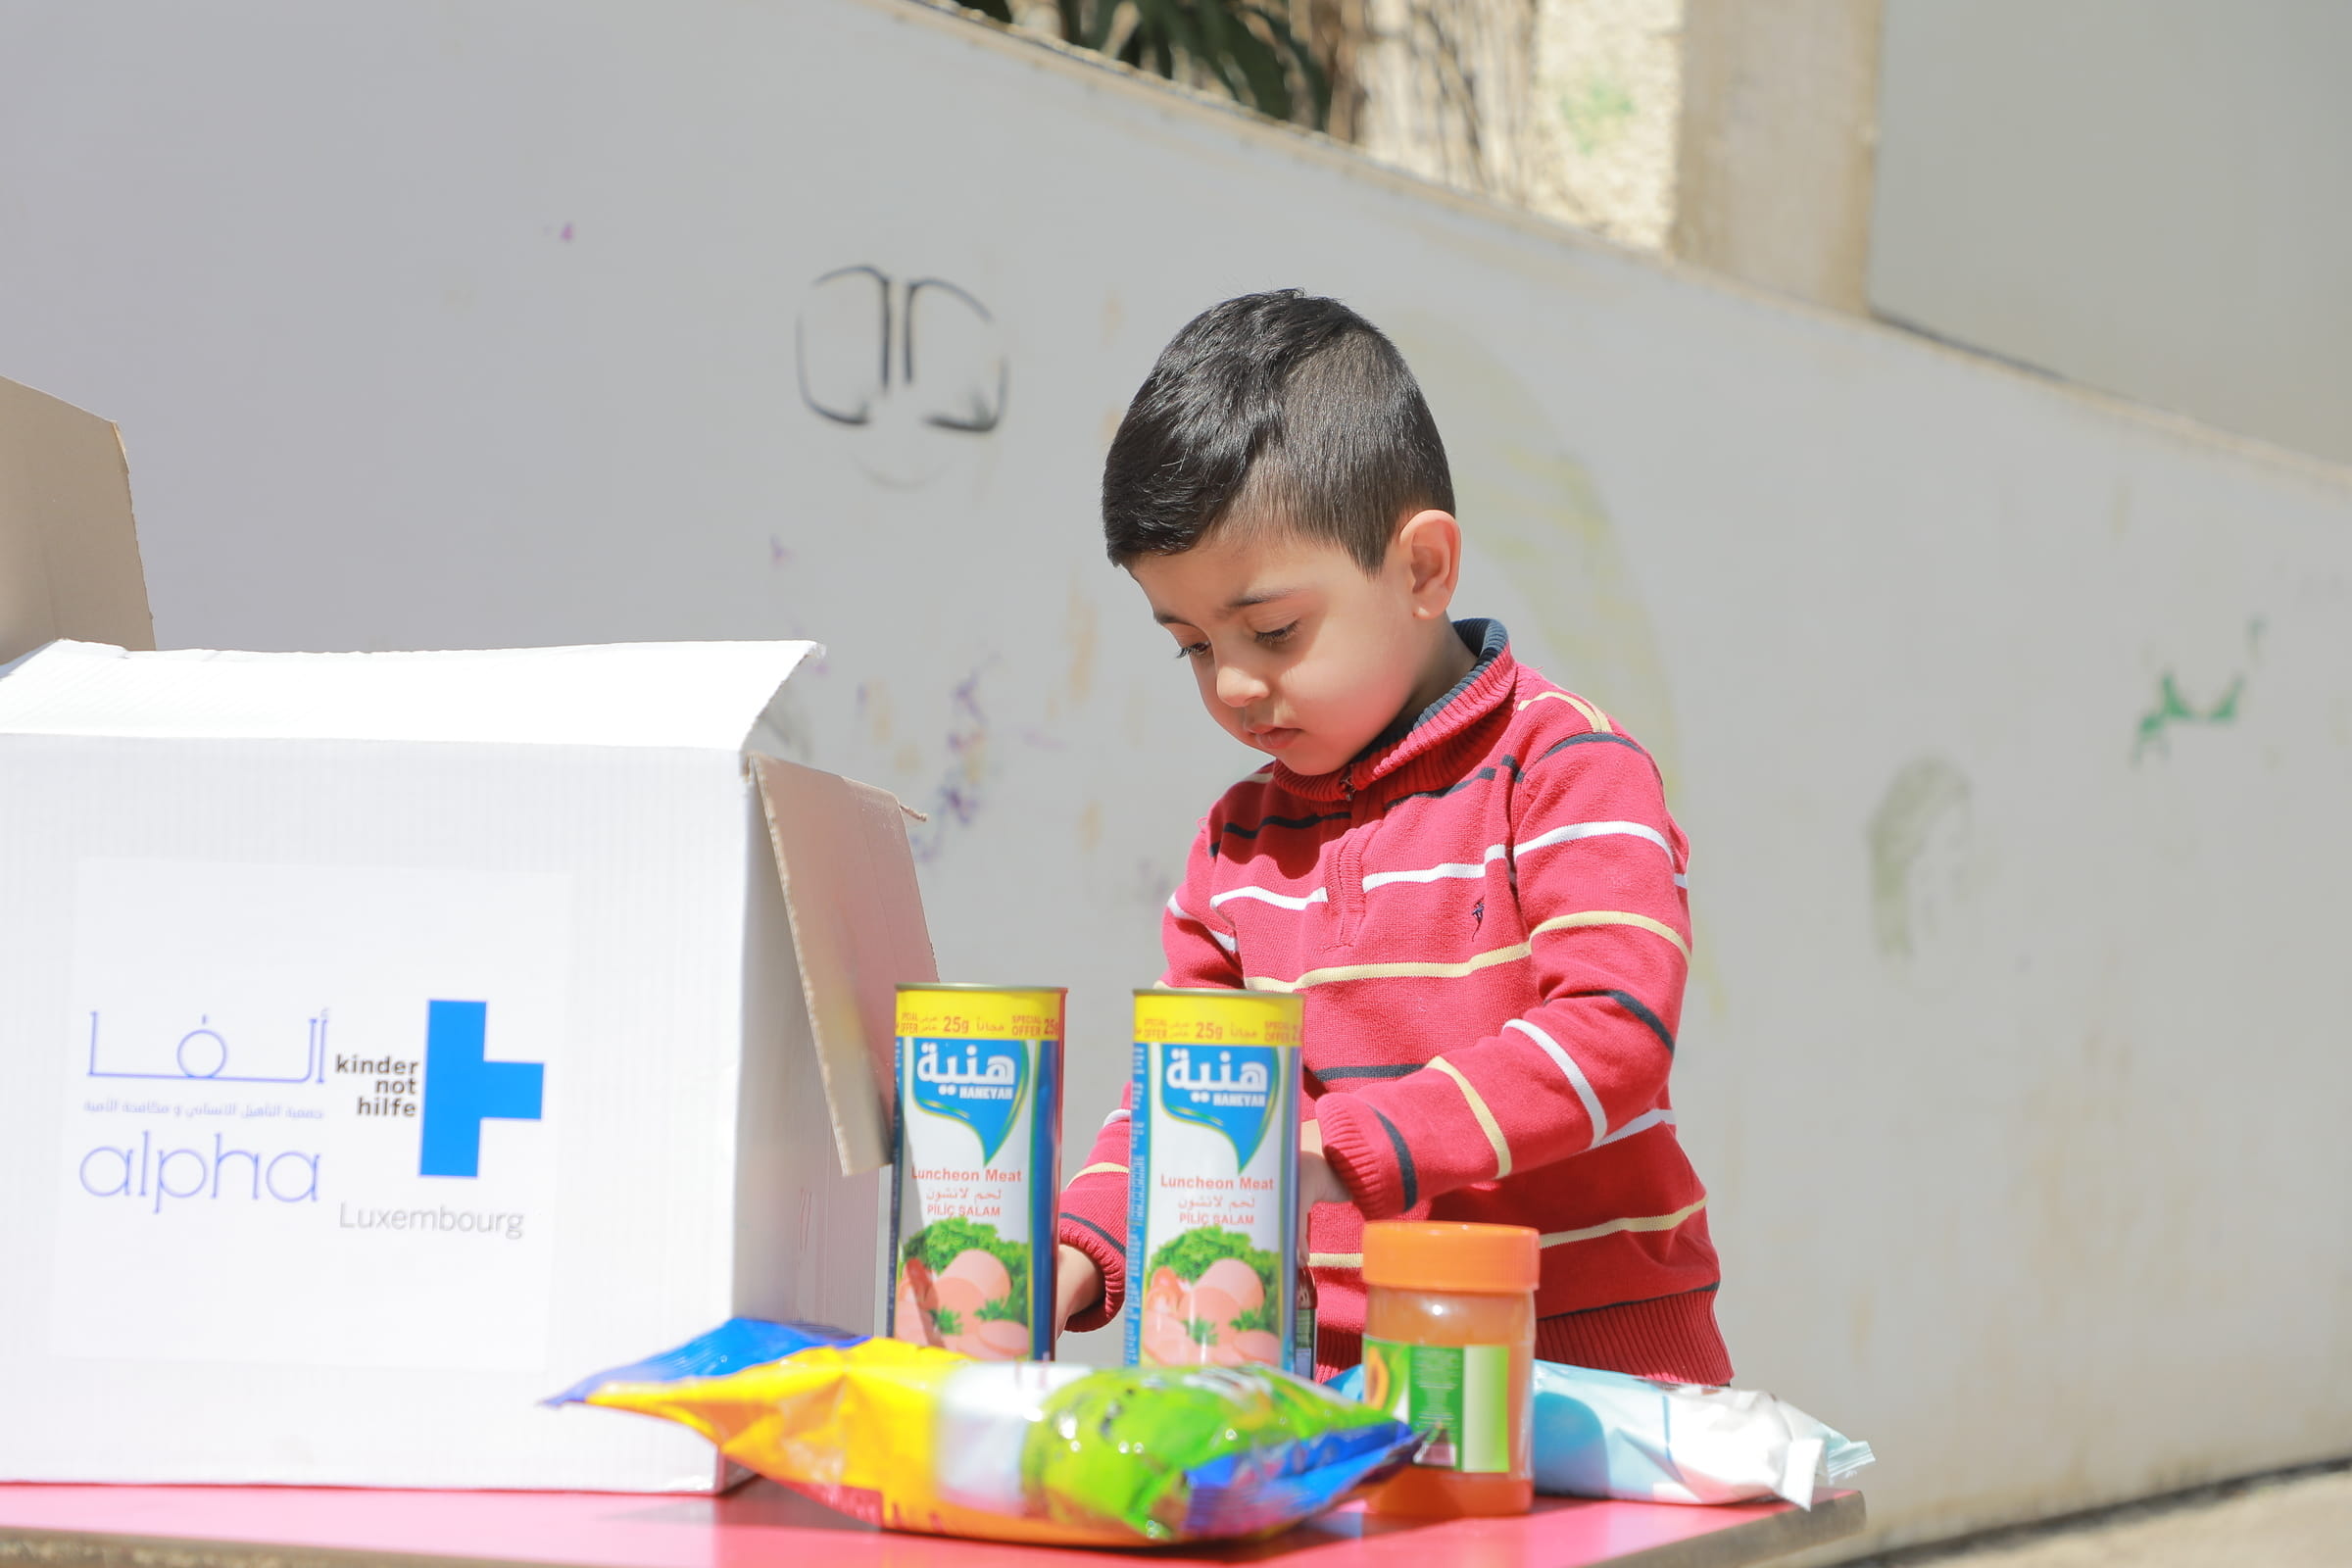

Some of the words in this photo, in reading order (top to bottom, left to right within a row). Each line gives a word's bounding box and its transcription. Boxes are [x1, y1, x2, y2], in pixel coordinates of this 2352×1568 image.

[943, 1016, 969, 1034] 25g
[1011, 1026, 1041, 1037] OFFER
[1195, 1022, 1223, 1040] 25g
[335, 1054, 420, 1076] kinder
[916, 1042, 1016, 1097] هنية
[1166, 1049, 1268, 1103] هنية
[375, 1077, 417, 1097] not
[357, 1097, 417, 1118] hilfe
[79, 1129, 321, 1214] alpha
[911, 1166, 980, 1182] Luncheon
[985, 1169, 1022, 1183] Meat
[1160, 1173, 1234, 1190] Luncheon
[1240, 1177, 1274, 1191] Meat
[338, 1201, 526, 1241] Luxembourg
[958, 1206, 1001, 1217] SALAM
[1213, 1214, 1255, 1225] SALAM
